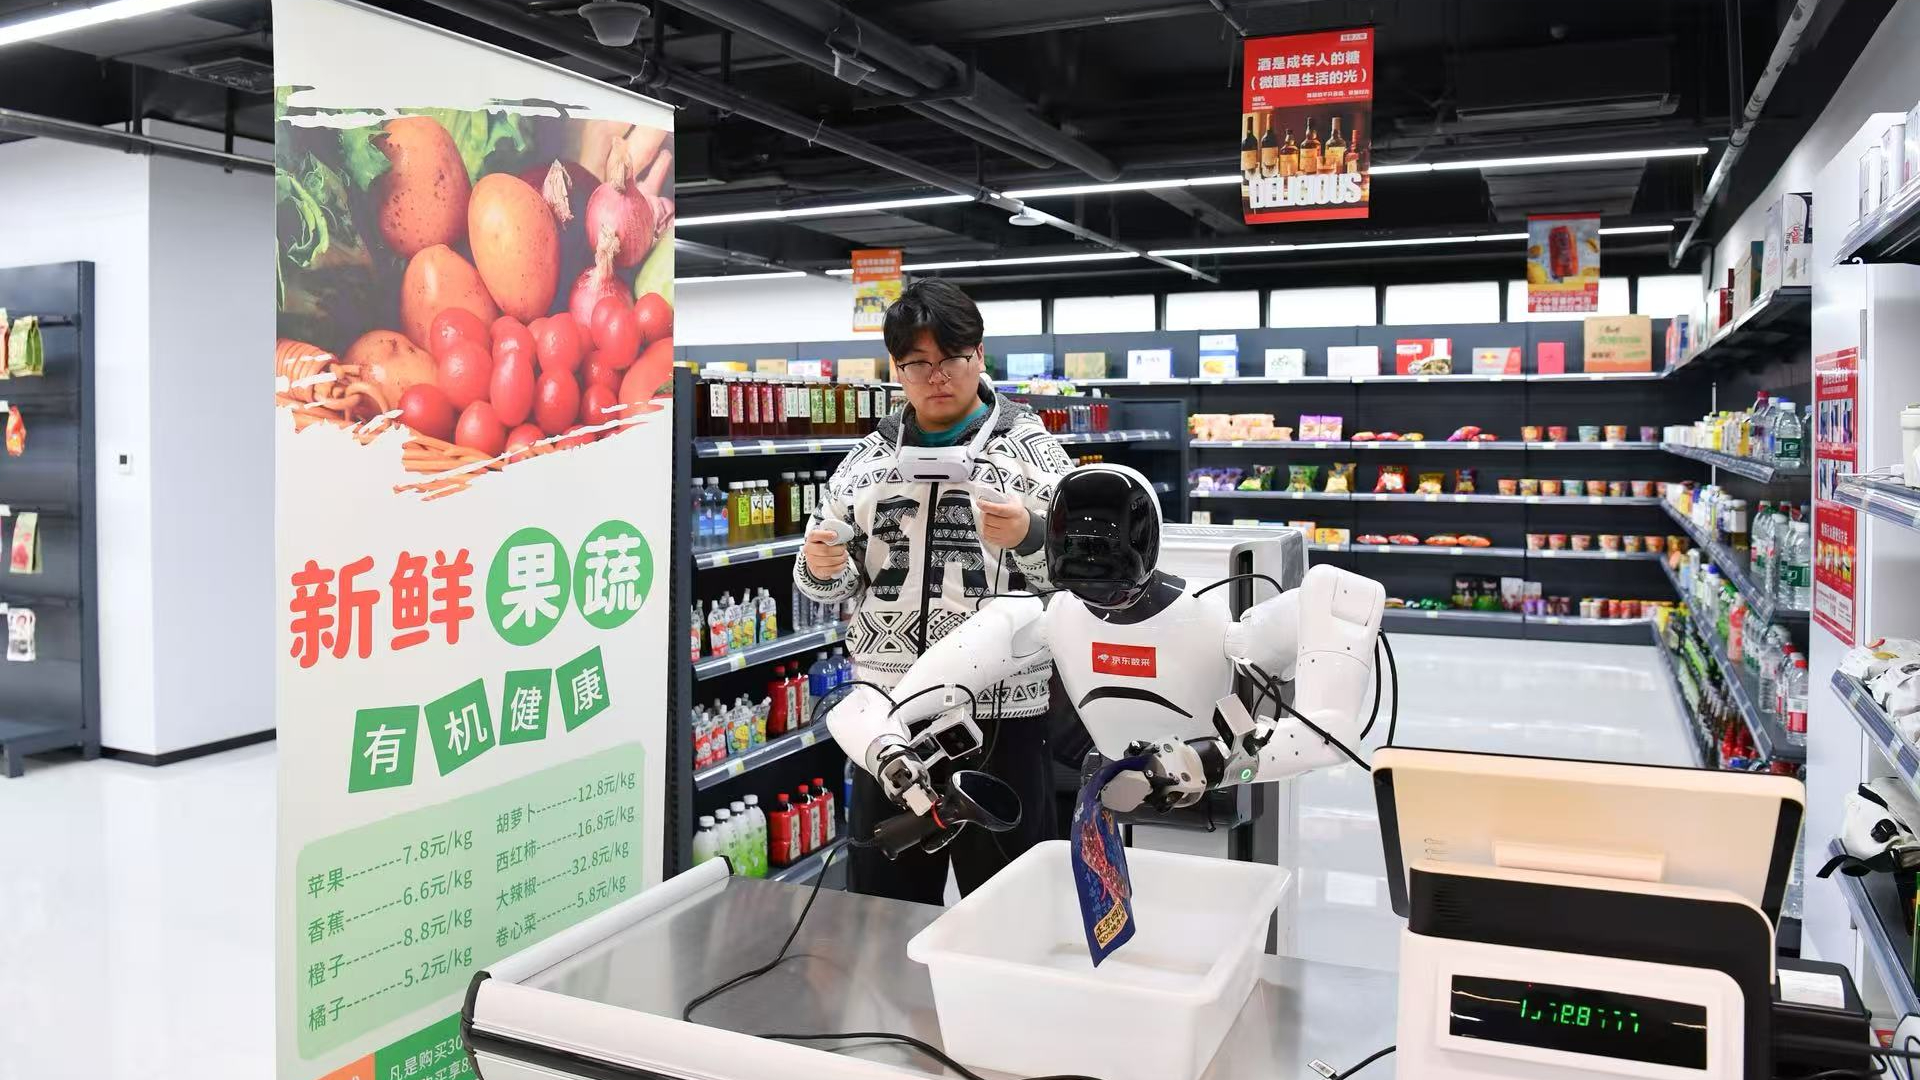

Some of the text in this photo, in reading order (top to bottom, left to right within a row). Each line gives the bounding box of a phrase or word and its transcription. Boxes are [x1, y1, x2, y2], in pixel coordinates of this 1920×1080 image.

[1258, 51, 1360, 71] 酒是成年人的糖
